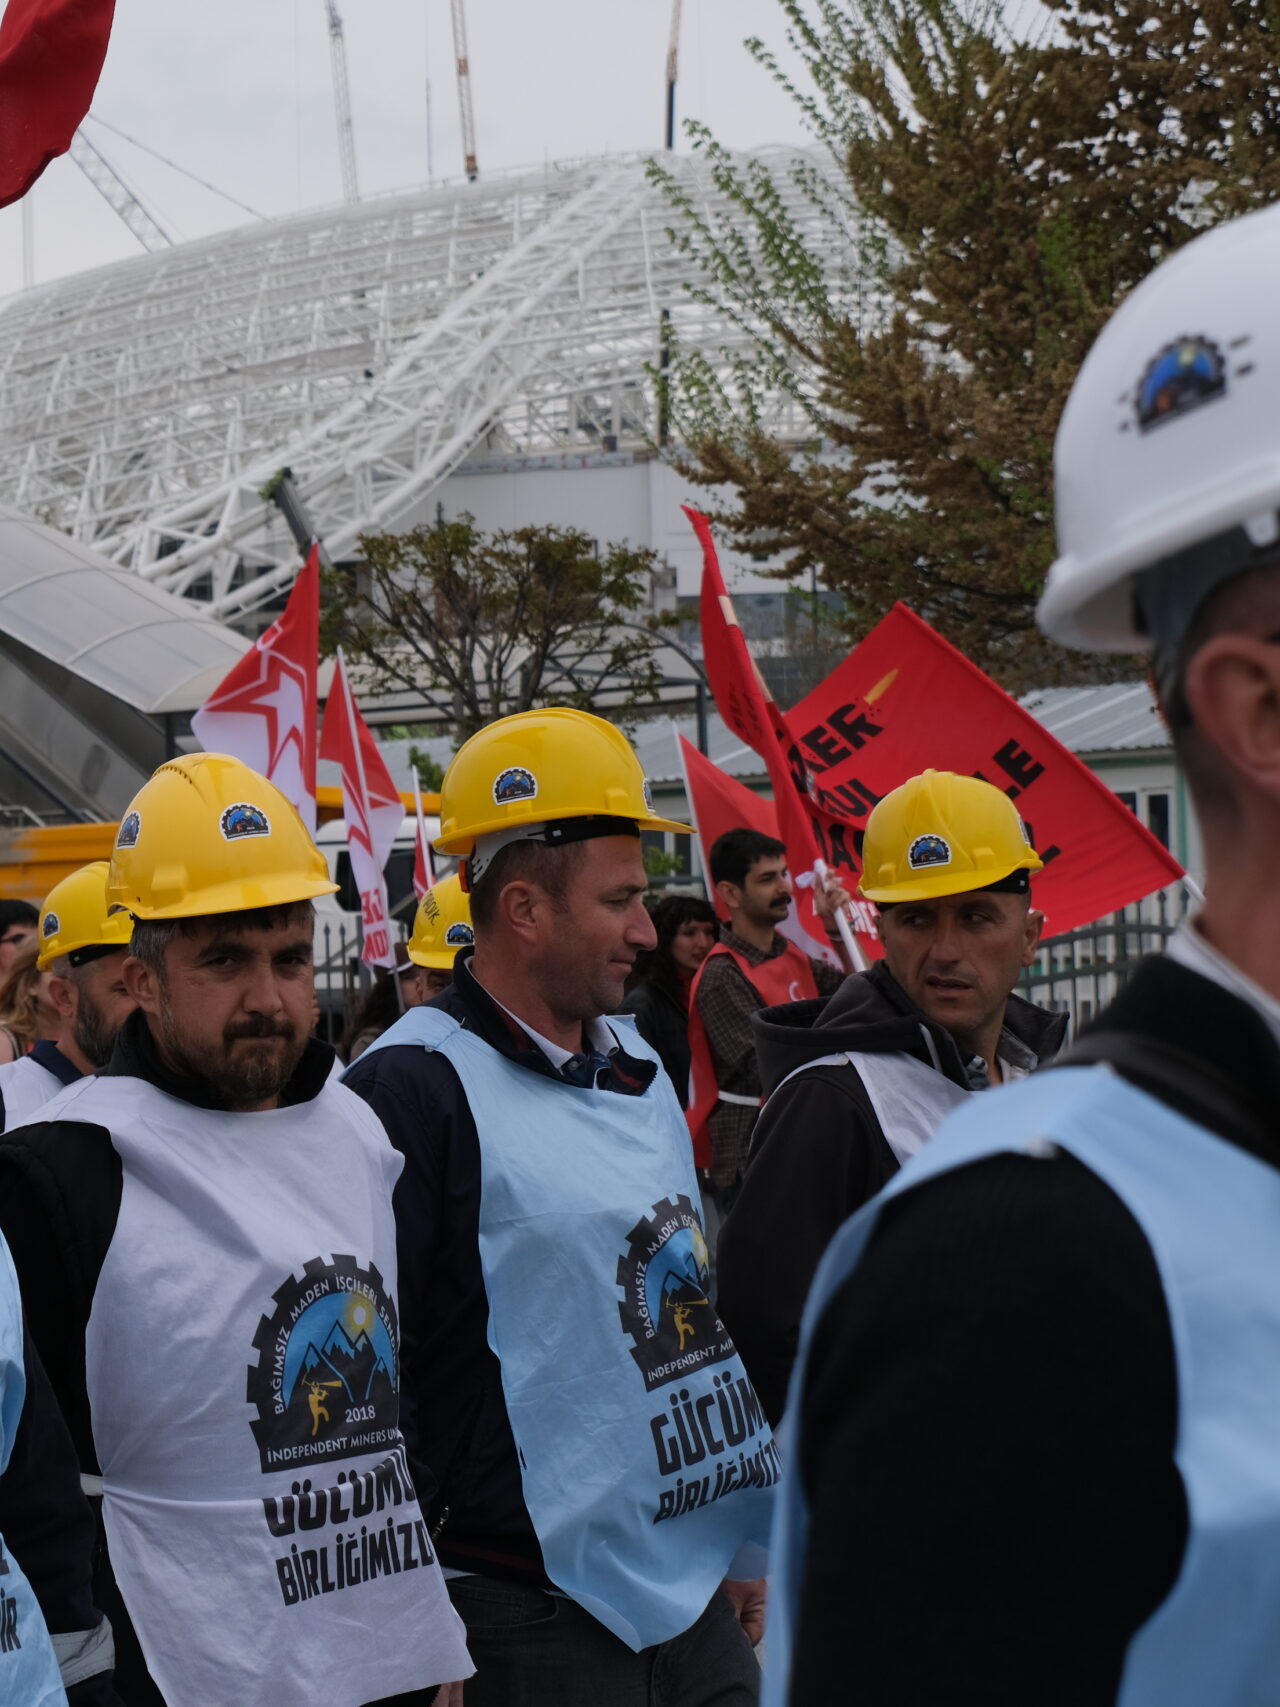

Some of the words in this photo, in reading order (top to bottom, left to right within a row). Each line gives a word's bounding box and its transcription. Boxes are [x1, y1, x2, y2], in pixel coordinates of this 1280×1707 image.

[635, 1260, 655, 1339] BAĞIMSIZ
[647, 1217, 679, 1255] MADEN
[270, 1326, 290, 1415] BAĞIMSIZ
[290, 1280, 330, 1322] MADEN
[335, 1273, 377, 1305] İŞÇİLERİ
[345, 1405, 376, 1423] 2018
[350, 1430, 387, 1448] MINERS
[650, 1370, 768, 1476] GÜCÜM
[276, 1517, 435, 1606] BİRLİĞİMİZD
